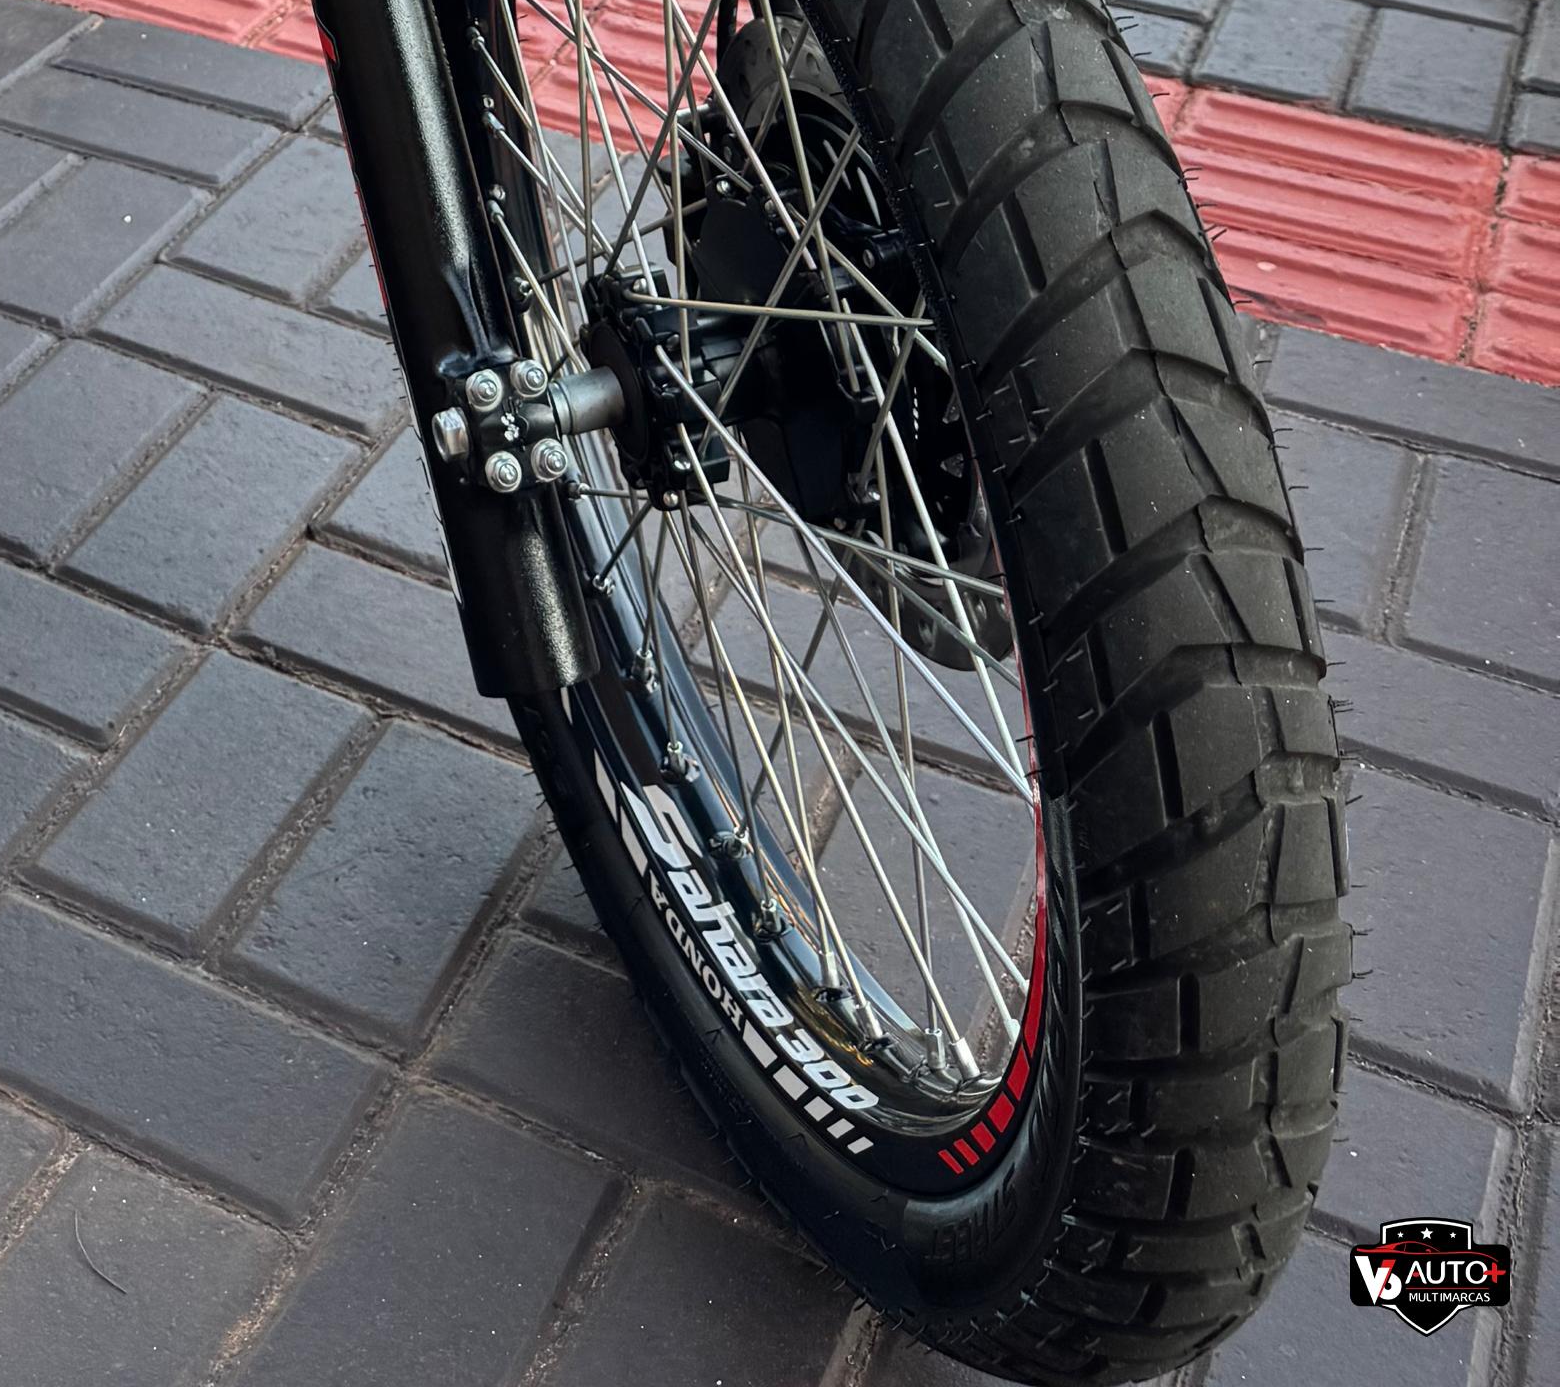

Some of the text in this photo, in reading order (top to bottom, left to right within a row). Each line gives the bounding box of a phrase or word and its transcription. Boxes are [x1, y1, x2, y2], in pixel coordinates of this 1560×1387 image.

[620, 781, 880, 1111] Sahara 300
[649, 868, 744, 1031] HONDA
